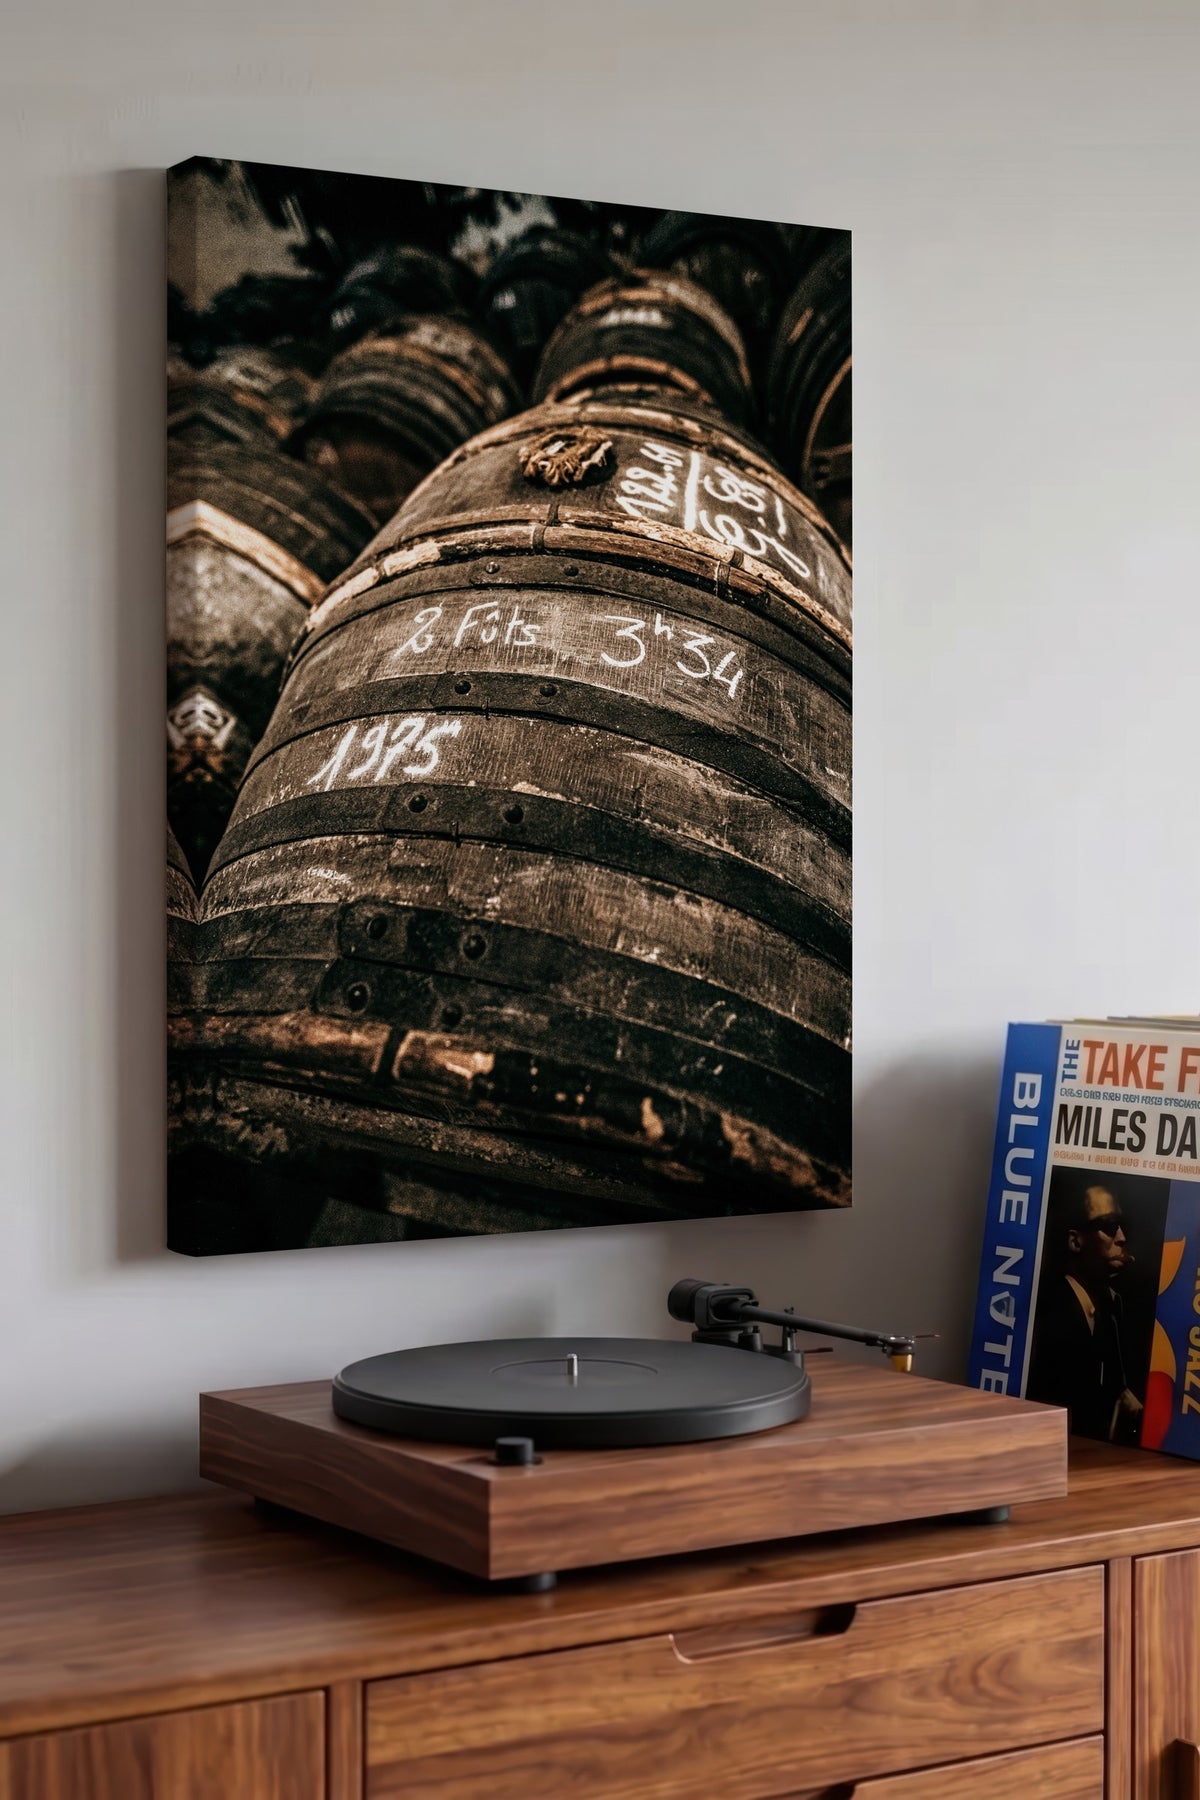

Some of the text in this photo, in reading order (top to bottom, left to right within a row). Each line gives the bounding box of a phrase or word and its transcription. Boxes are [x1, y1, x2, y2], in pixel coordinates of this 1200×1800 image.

[306, 717, 462, 792] 1975
[1061, 1039, 1081, 1083] THE
[1083, 1039, 1200, 1095] TAKE F
[998, 1072, 1043, 1225] BLUE
[1055, 1103, 1147, 1153] MILES
